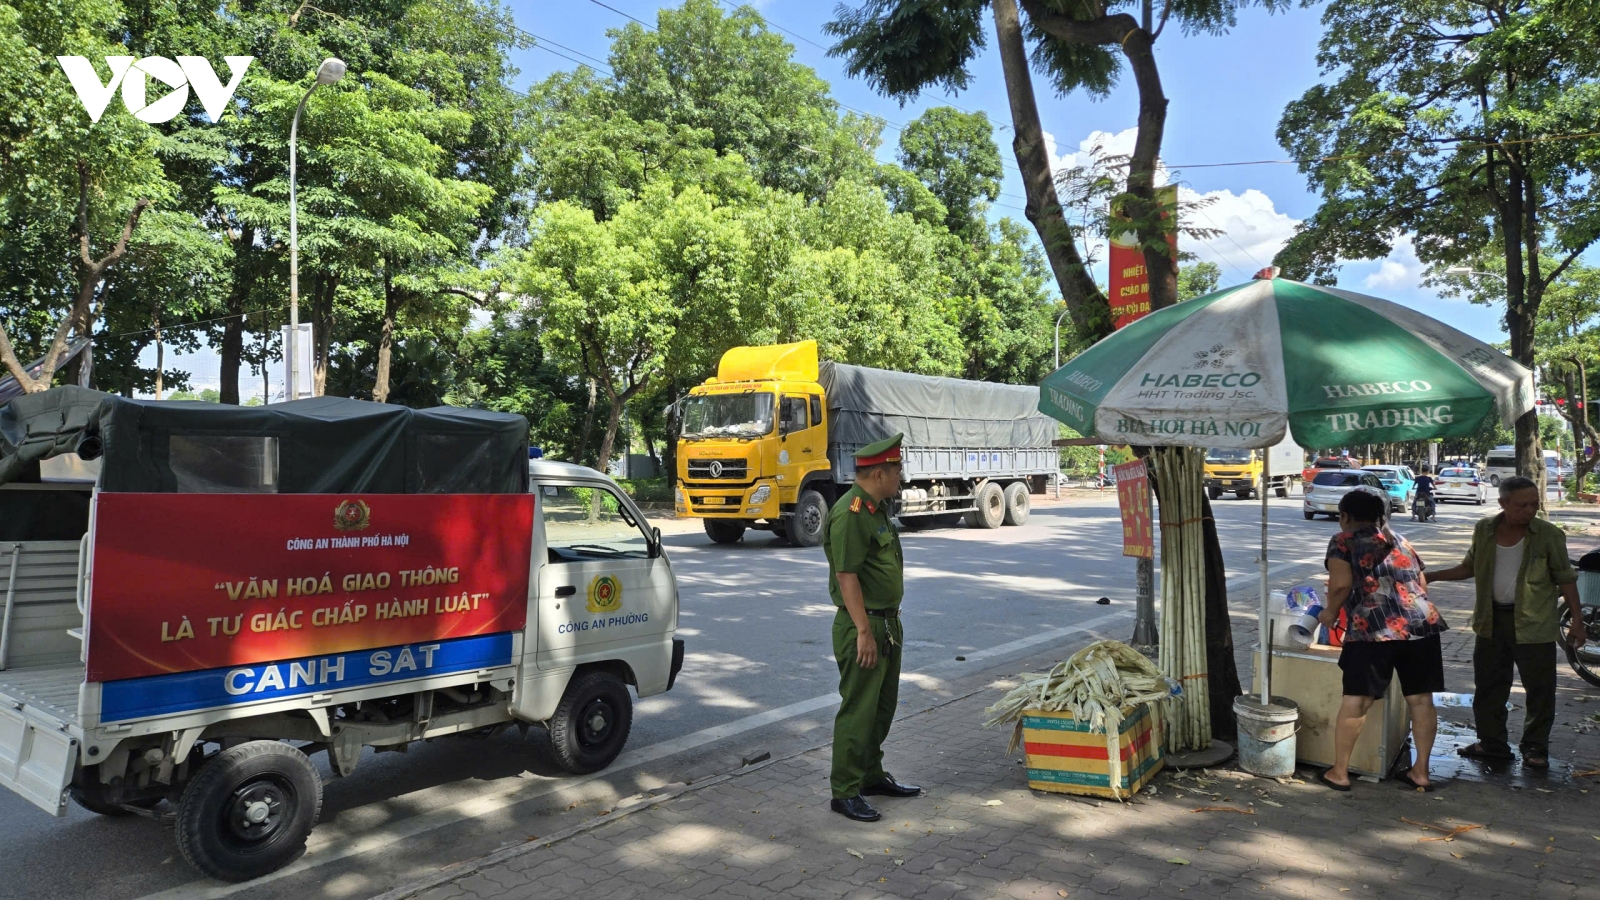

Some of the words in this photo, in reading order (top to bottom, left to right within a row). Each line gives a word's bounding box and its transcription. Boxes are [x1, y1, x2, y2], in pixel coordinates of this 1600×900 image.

[1066, 370, 1103, 392] HABECO
[1140, 372, 1261, 388] HABECO
[1321, 380, 1432, 398] HABECO
[1049, 388, 1084, 422] TRADING
[1138, 390, 1169, 399] HHT
[1174, 390, 1225, 400] Trading
[1229, 390, 1257, 399] Jsc.
[1149, 419, 1186, 434] HƠI
[1190, 416, 1220, 436] HÀ
[1224, 418, 1262, 441] NỘI
[1325, 405, 1454, 433] TRADING
[287, 537, 314, 550] CÔNG
[315, 538, 329, 549] AN
[331, 535, 360, 548] THÀNH
[362, 532, 380, 547] PHỐ
[381, 533, 393, 546] HÀ
[394, 533, 409, 547] NỘI
[287, 571, 334, 596] HOÁ
[342, 572, 391, 591] GIAO
[399, 565, 459, 587] THÔNG
[161, 615, 195, 642] LÀ
[207, 613, 244, 639] TỰ
[250, 607, 303, 632] GIÁC
[312, 599, 367, 627] CHẤP
[375, 597, 428, 620] HÀNH
[558, 620, 588, 634] CÔNG
[591, 619, 605, 629] AN
[608, 612, 648, 627] PHƯỜNG
[368, 644, 440, 676] SÁT
